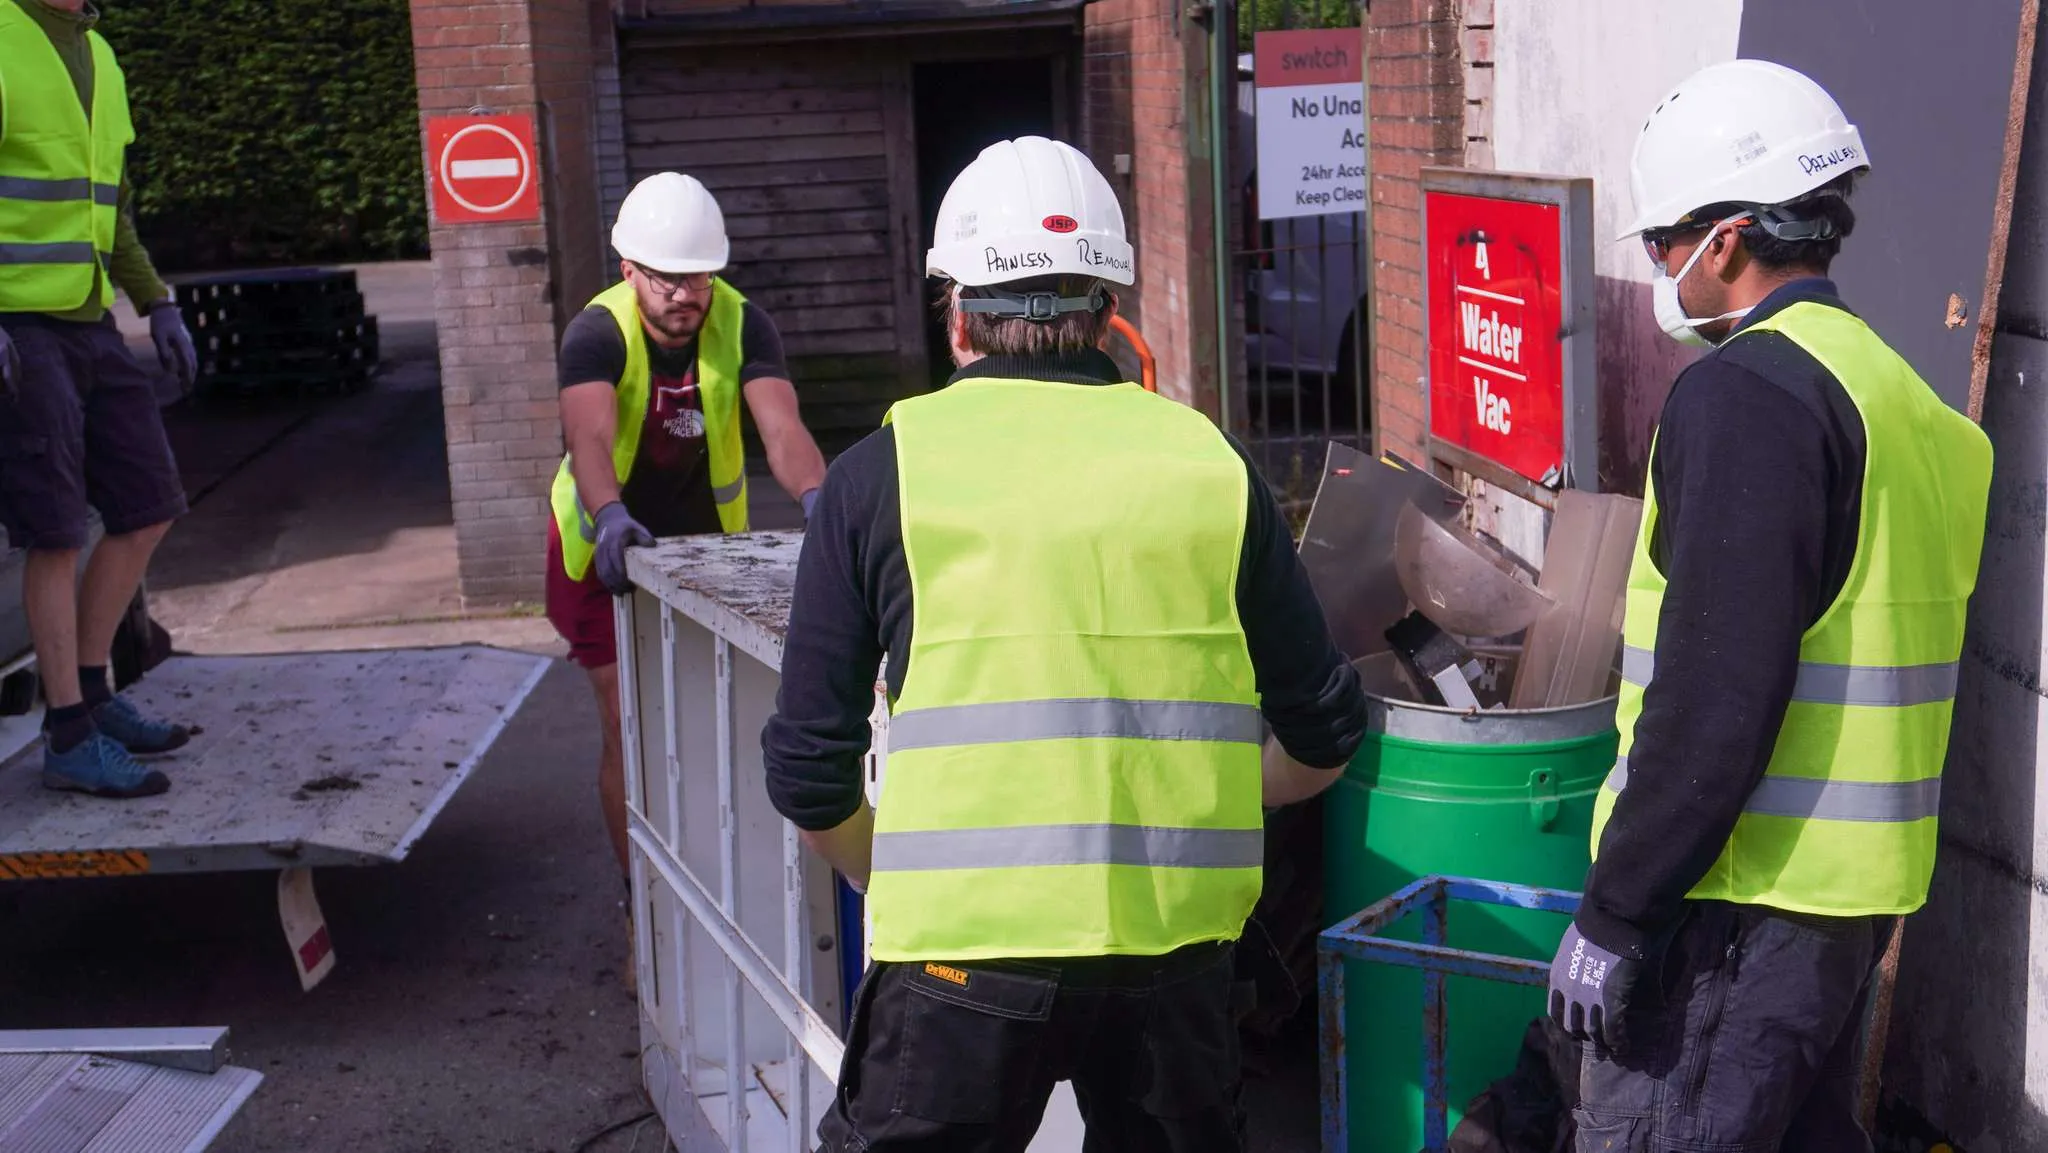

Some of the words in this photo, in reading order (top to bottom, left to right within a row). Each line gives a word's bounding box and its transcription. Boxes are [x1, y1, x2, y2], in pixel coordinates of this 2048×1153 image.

[1281, 46, 1348, 71] switch
[1291, 96, 1319, 118] No
[1301, 165, 1333, 181] 24hr
[1798, 145, 1859, 176] PAINLESS
[1296, 189, 1330, 206] Keep
[1047, 218, 1073, 229] JSP
[984, 246, 1054, 273] PAINLESS
[1461, 301, 1523, 364] Water
[1473, 376, 1511, 435] Vac
